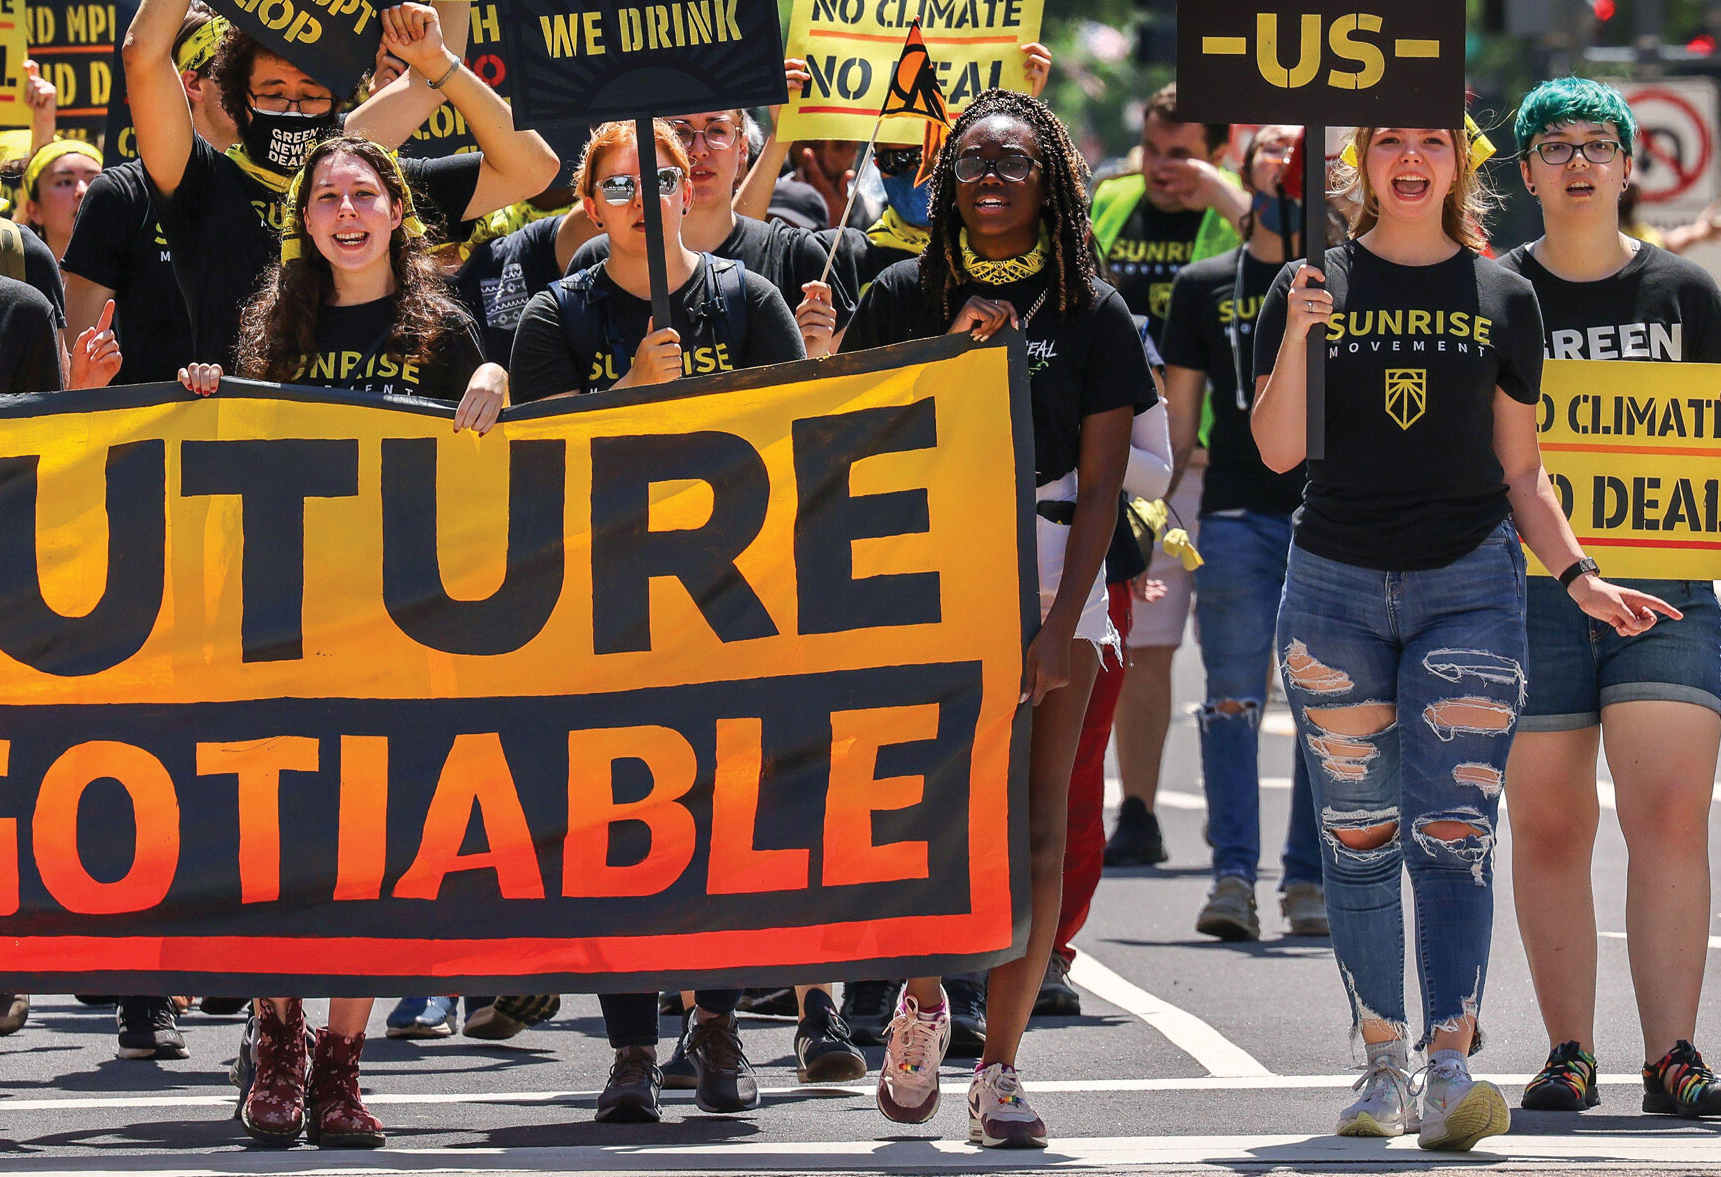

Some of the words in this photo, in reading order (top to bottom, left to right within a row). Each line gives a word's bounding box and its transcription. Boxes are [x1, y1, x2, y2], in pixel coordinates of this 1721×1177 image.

[539, 9, 607, 60] WE
[800, 54, 872, 100] NO
[269, 139, 304, 155] NEW
[271, 127, 319, 143] GREEN
[268, 150, 305, 167] DEAL
[1325, 309, 1492, 345] SUNRISE
[1329, 340, 1485, 359] MOVEMENT
[1544, 322, 1682, 361] REEN
